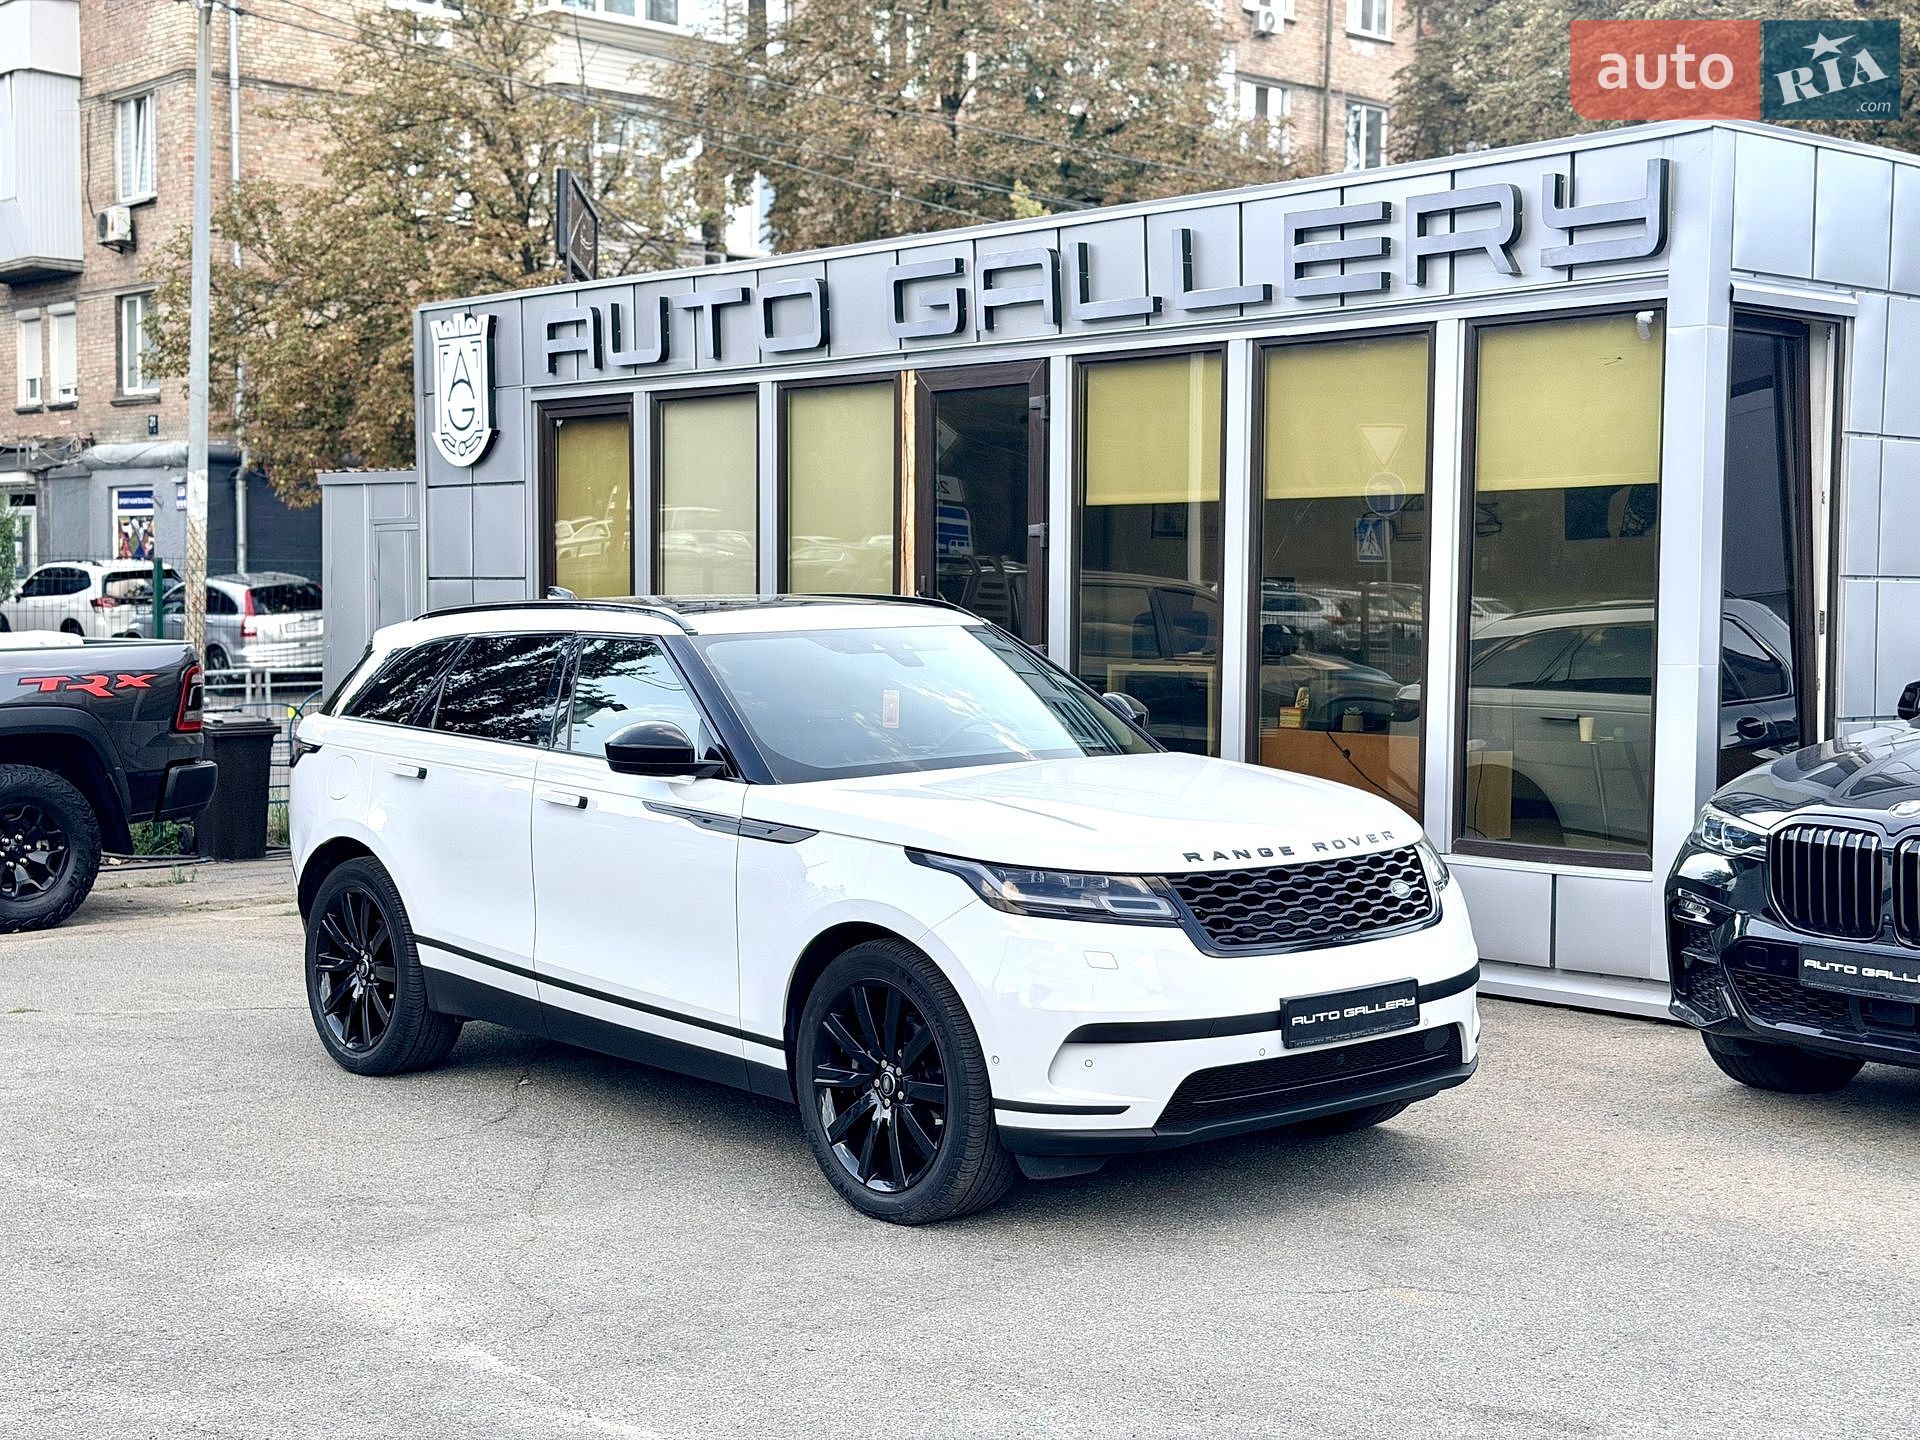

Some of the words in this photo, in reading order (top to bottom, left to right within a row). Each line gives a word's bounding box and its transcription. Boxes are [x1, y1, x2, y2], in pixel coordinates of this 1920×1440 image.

[543, 278, 831, 375] AUTO
[886, 157, 1671, 340] GALLERY
[18, 673, 159, 698] TRX
[1182, 845, 1295, 863] RANGE
[1311, 830, 1396, 852] ROVER
[1804, 959, 1858, 975] AUTO
[1291, 1010, 1340, 1026] AUTO
[1343, 996, 1416, 1018] GALLERY
